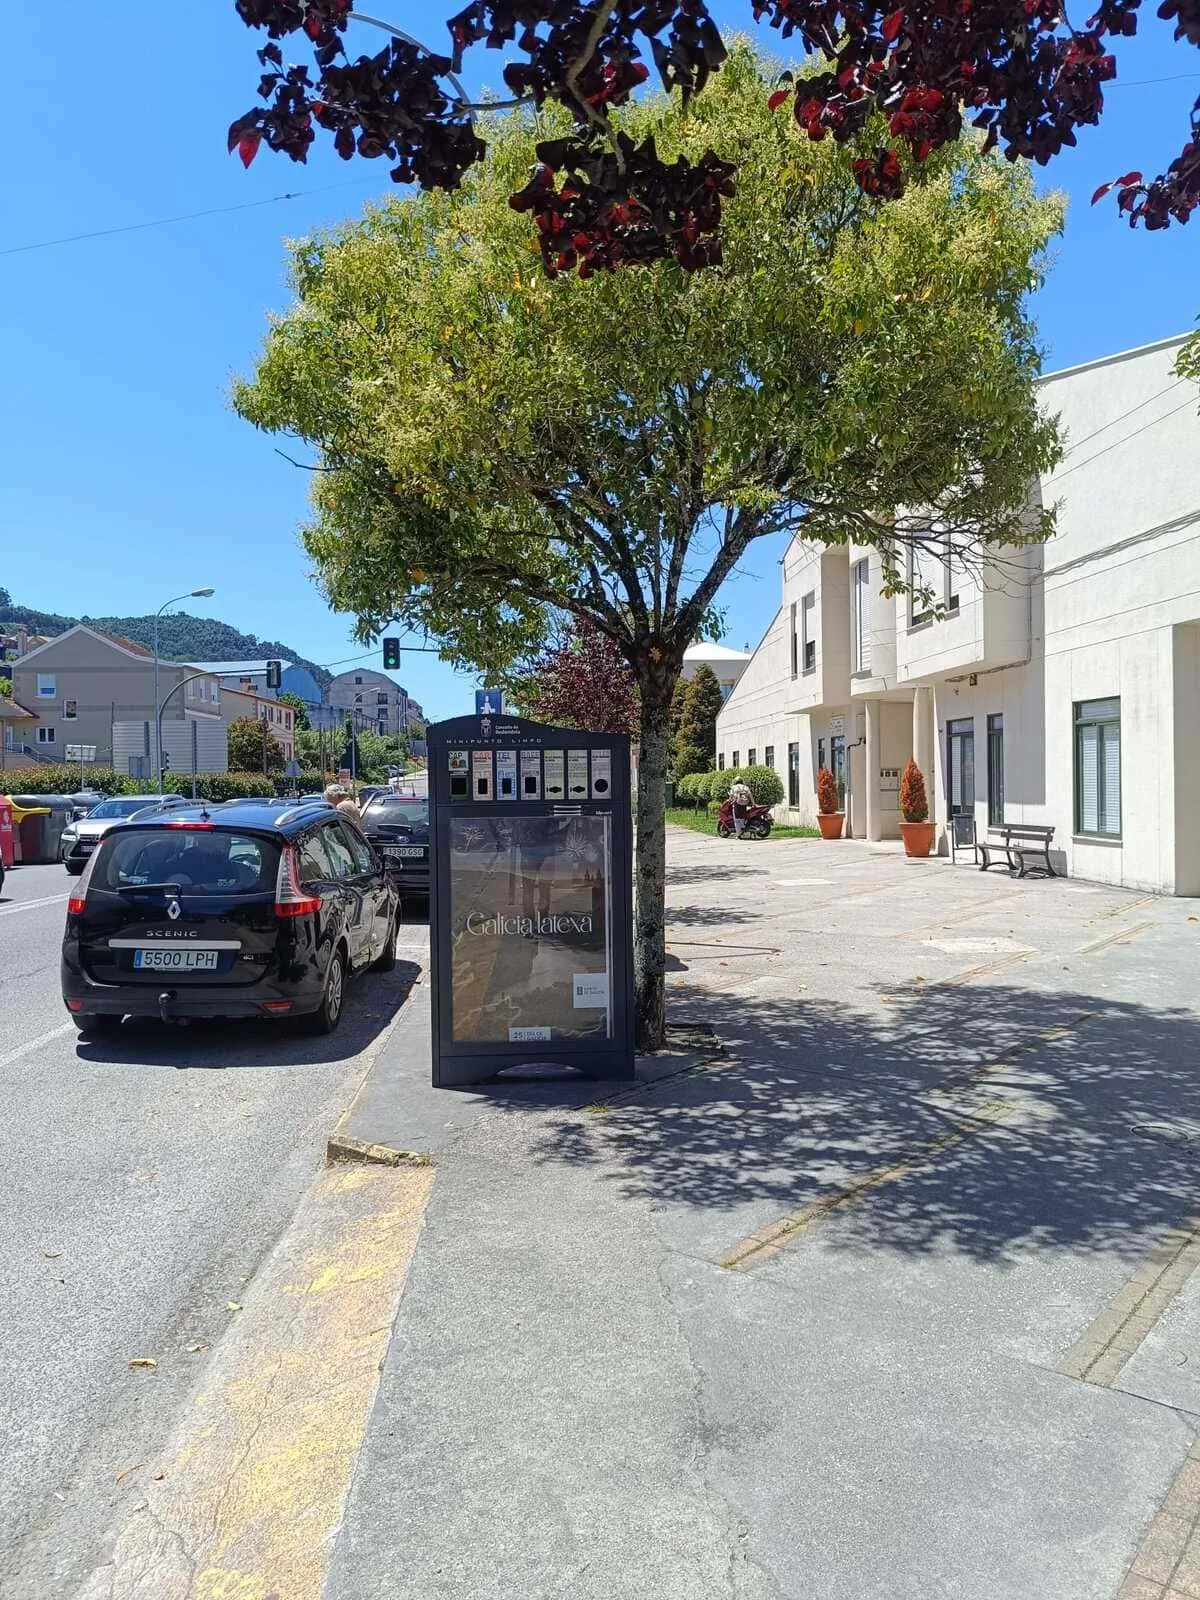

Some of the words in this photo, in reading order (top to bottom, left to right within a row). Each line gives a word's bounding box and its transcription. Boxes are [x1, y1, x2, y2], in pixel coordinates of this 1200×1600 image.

[466, 911, 532, 936] Galicia
[144, 952, 182, 966] 5500
[186, 952, 215, 966] LPH
